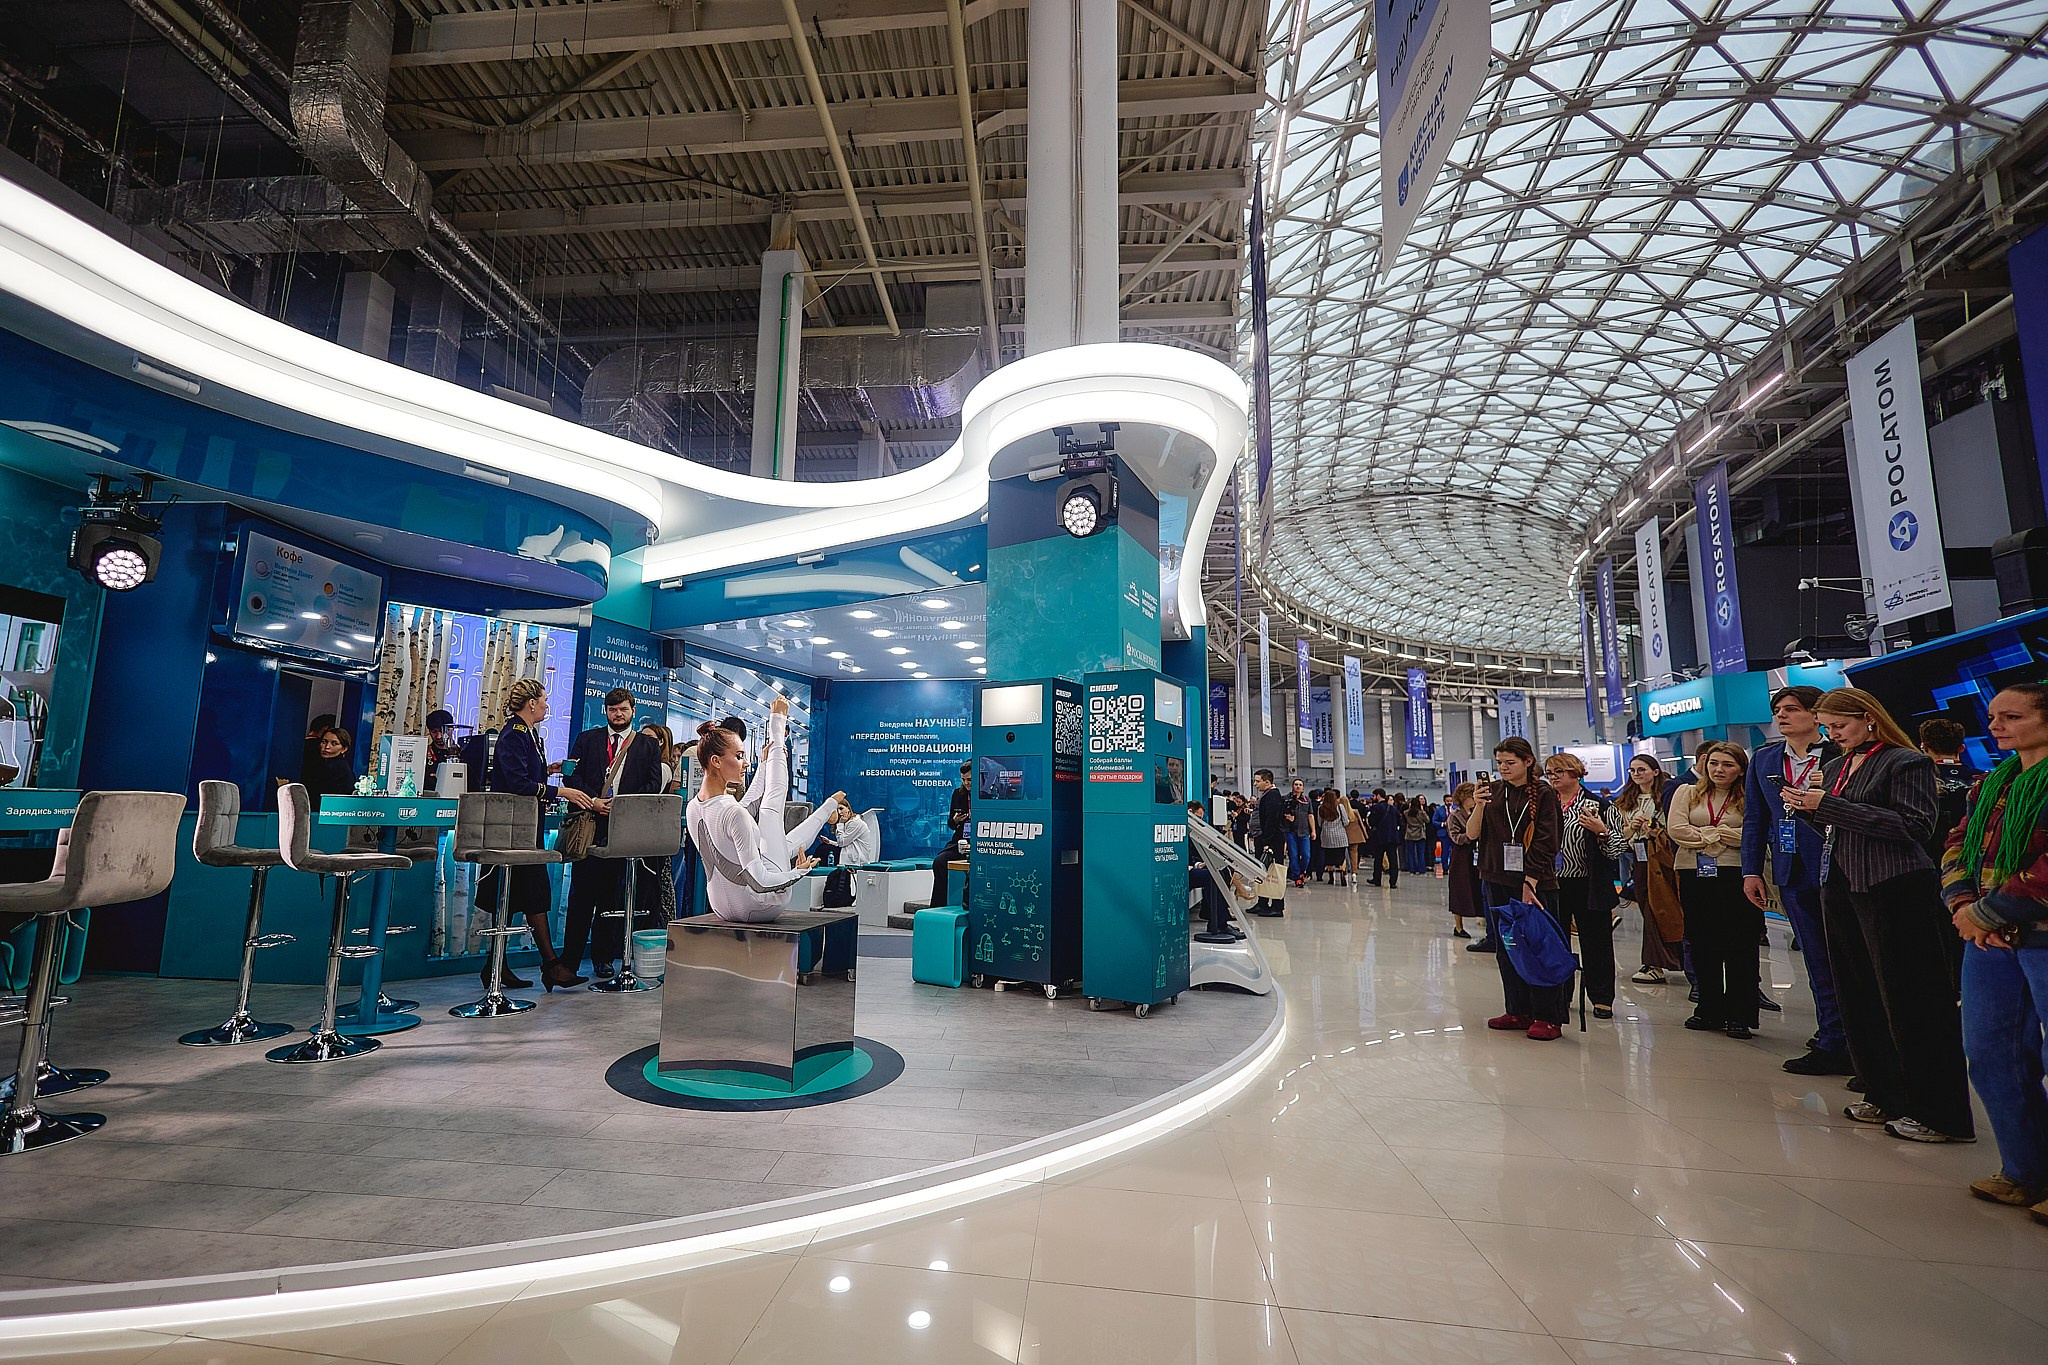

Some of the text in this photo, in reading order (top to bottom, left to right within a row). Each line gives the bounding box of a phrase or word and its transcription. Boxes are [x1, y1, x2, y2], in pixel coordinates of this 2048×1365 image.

[1397, 3, 1449, 135] STRATEGIC RESEARCH
[1410, 60, 1435, 118] PARTNER
[1409, 54, 1454, 164] KURCHATOV
[1410, 103, 1446, 186] INSTITUTE
[1874, 358, 1908, 507] РОСАТОМ
[1707, 483, 1726, 593] ROSATOM
[276, 546, 303, 564] Кофе
[1644, 537, 1659, 629] РОСАТОМ
[1603, 571, 1614, 652] ROSATOM
[606, 636, 630, 647] ЗАЯВИ
[635, 644, 648, 653] себе
[594, 647, 659, 670] ПОЛИМЕРНОЙ
[619, 667, 638, 678] Прими
[612, 678, 660, 696] ХАКАТОНЕ
[1089, 684, 1119, 693] СИБУР
[1660, 697, 1702, 717] ROSATOM
[915, 719, 966, 728] НАУЧНЫЕ
[855, 733, 901, 741] ПЕРЕДОВЫЕ
[380, 753, 388, 776] СИБУР
[890, 758, 922, 766] продукты
[1089, 757, 1113, 765] Собирай
[865, 768, 917, 777] БЕЗОПАСНОЙ
[1000, 770, 1023, 778] СИБУР
[1097, 774, 1118, 782] крутые
[1117, 774, 1143, 782] подарки
[5, 807, 52, 817] Зарядись
[976, 821, 1043, 840] СИБУР
[1154, 824, 1187, 843] СИБУР
[976, 841, 1015, 849] НАУКА БЛИЖЕ,
[996, 848, 1025, 856] ДУМАЕШЬ
